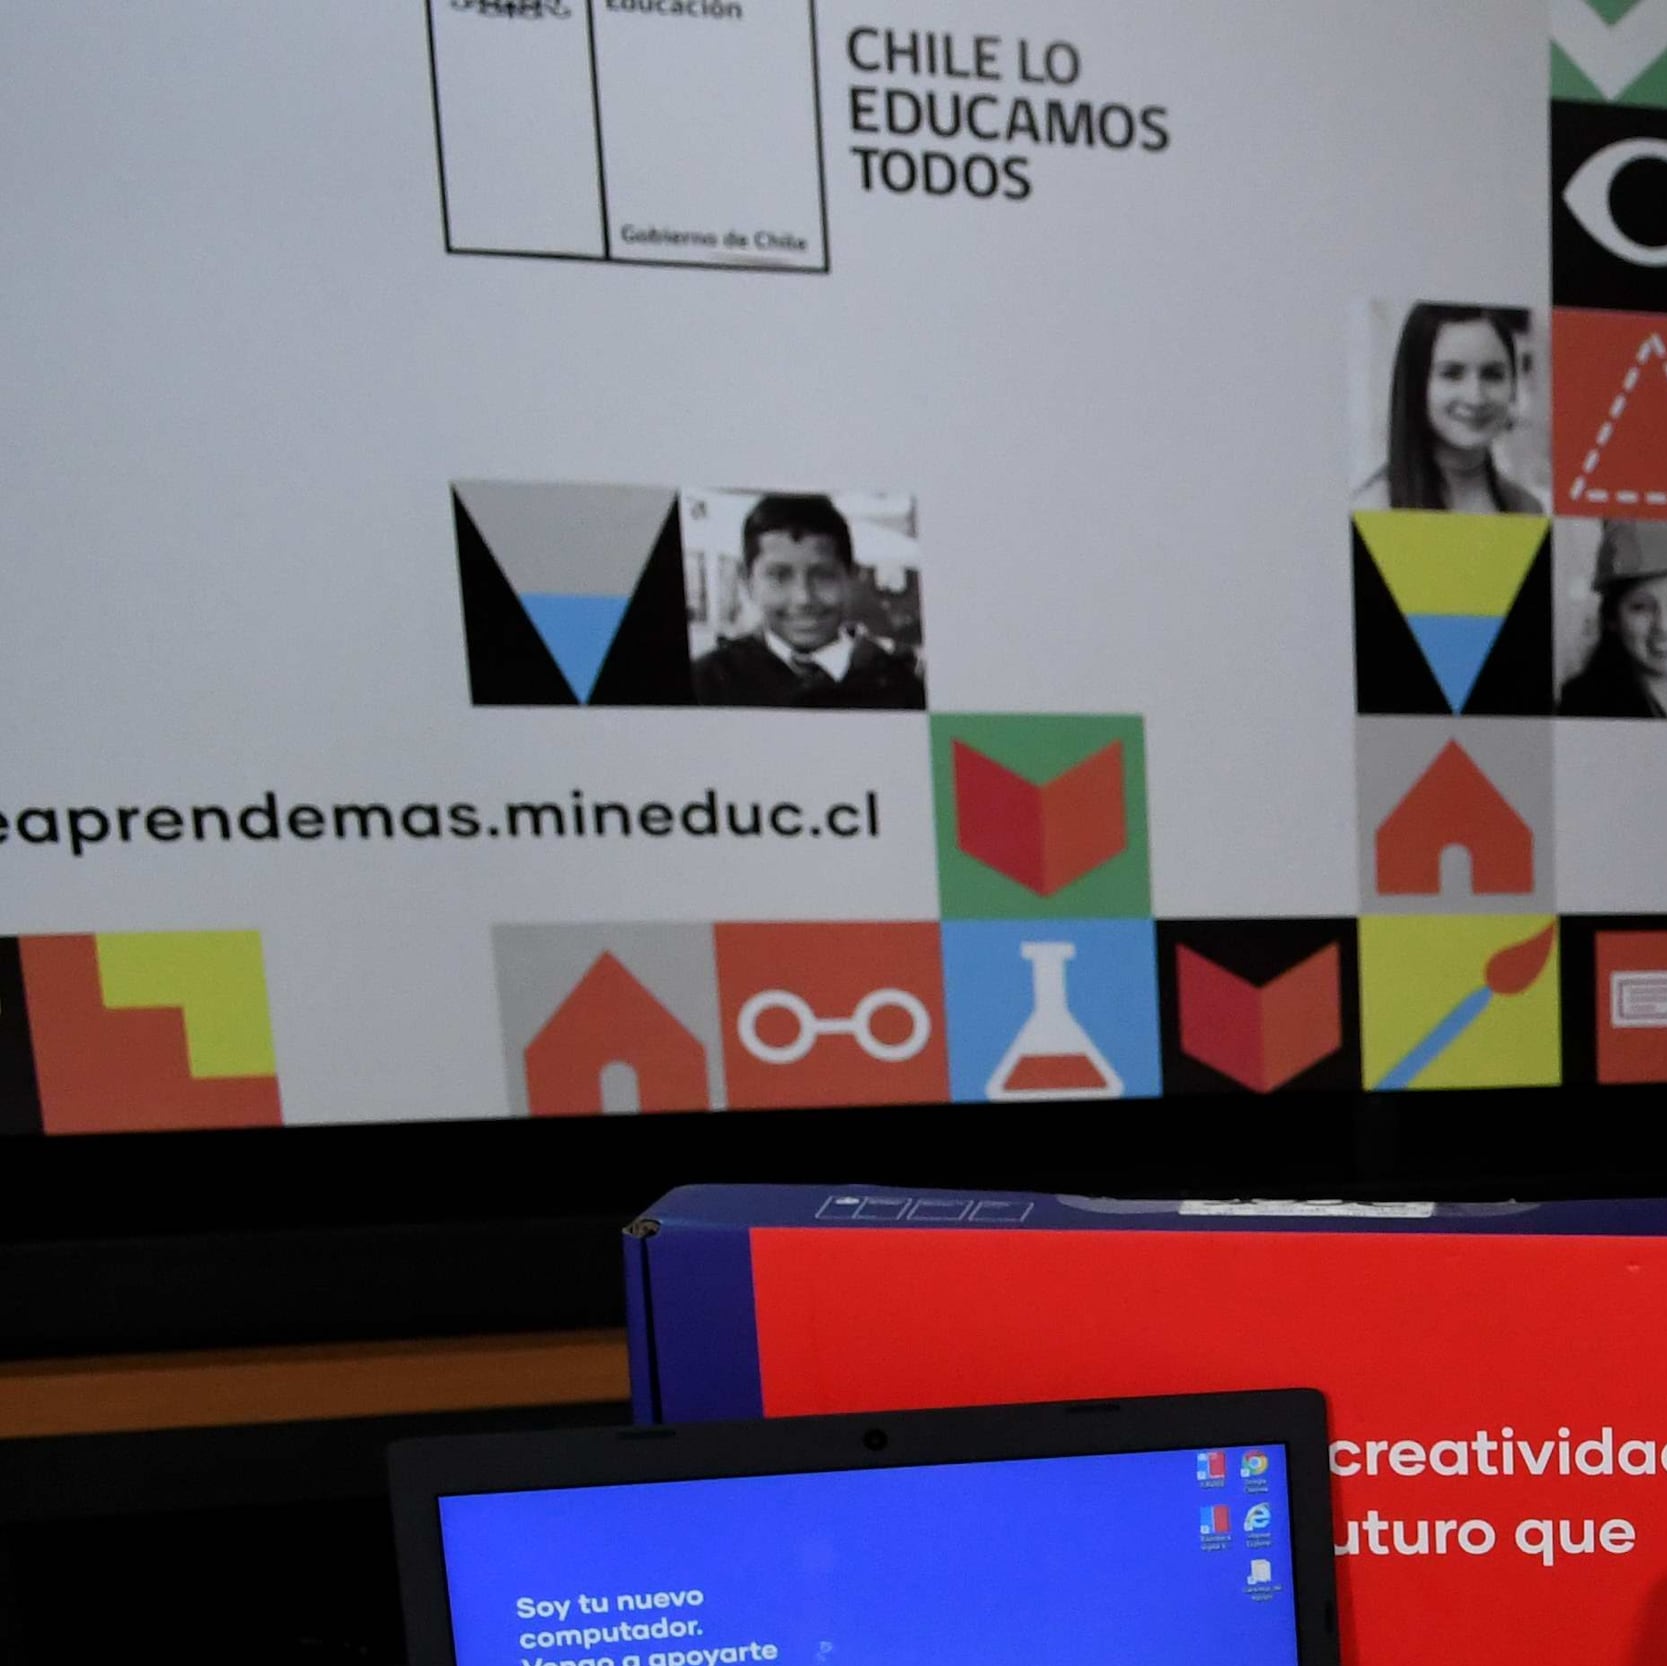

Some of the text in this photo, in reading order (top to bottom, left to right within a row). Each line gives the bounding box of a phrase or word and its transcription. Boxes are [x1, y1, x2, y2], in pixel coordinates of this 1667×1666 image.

[847, 27, 1081, 84] CHILE LO
[848, 86, 1171, 152] EDUCAMOS
[855, 147, 1033, 200] TODOS
[1335, 1510, 1635, 1567] uturo que
[517, 1589, 704, 1621] Soy tu nuevo
[519, 1617, 703, 1649] computador.
